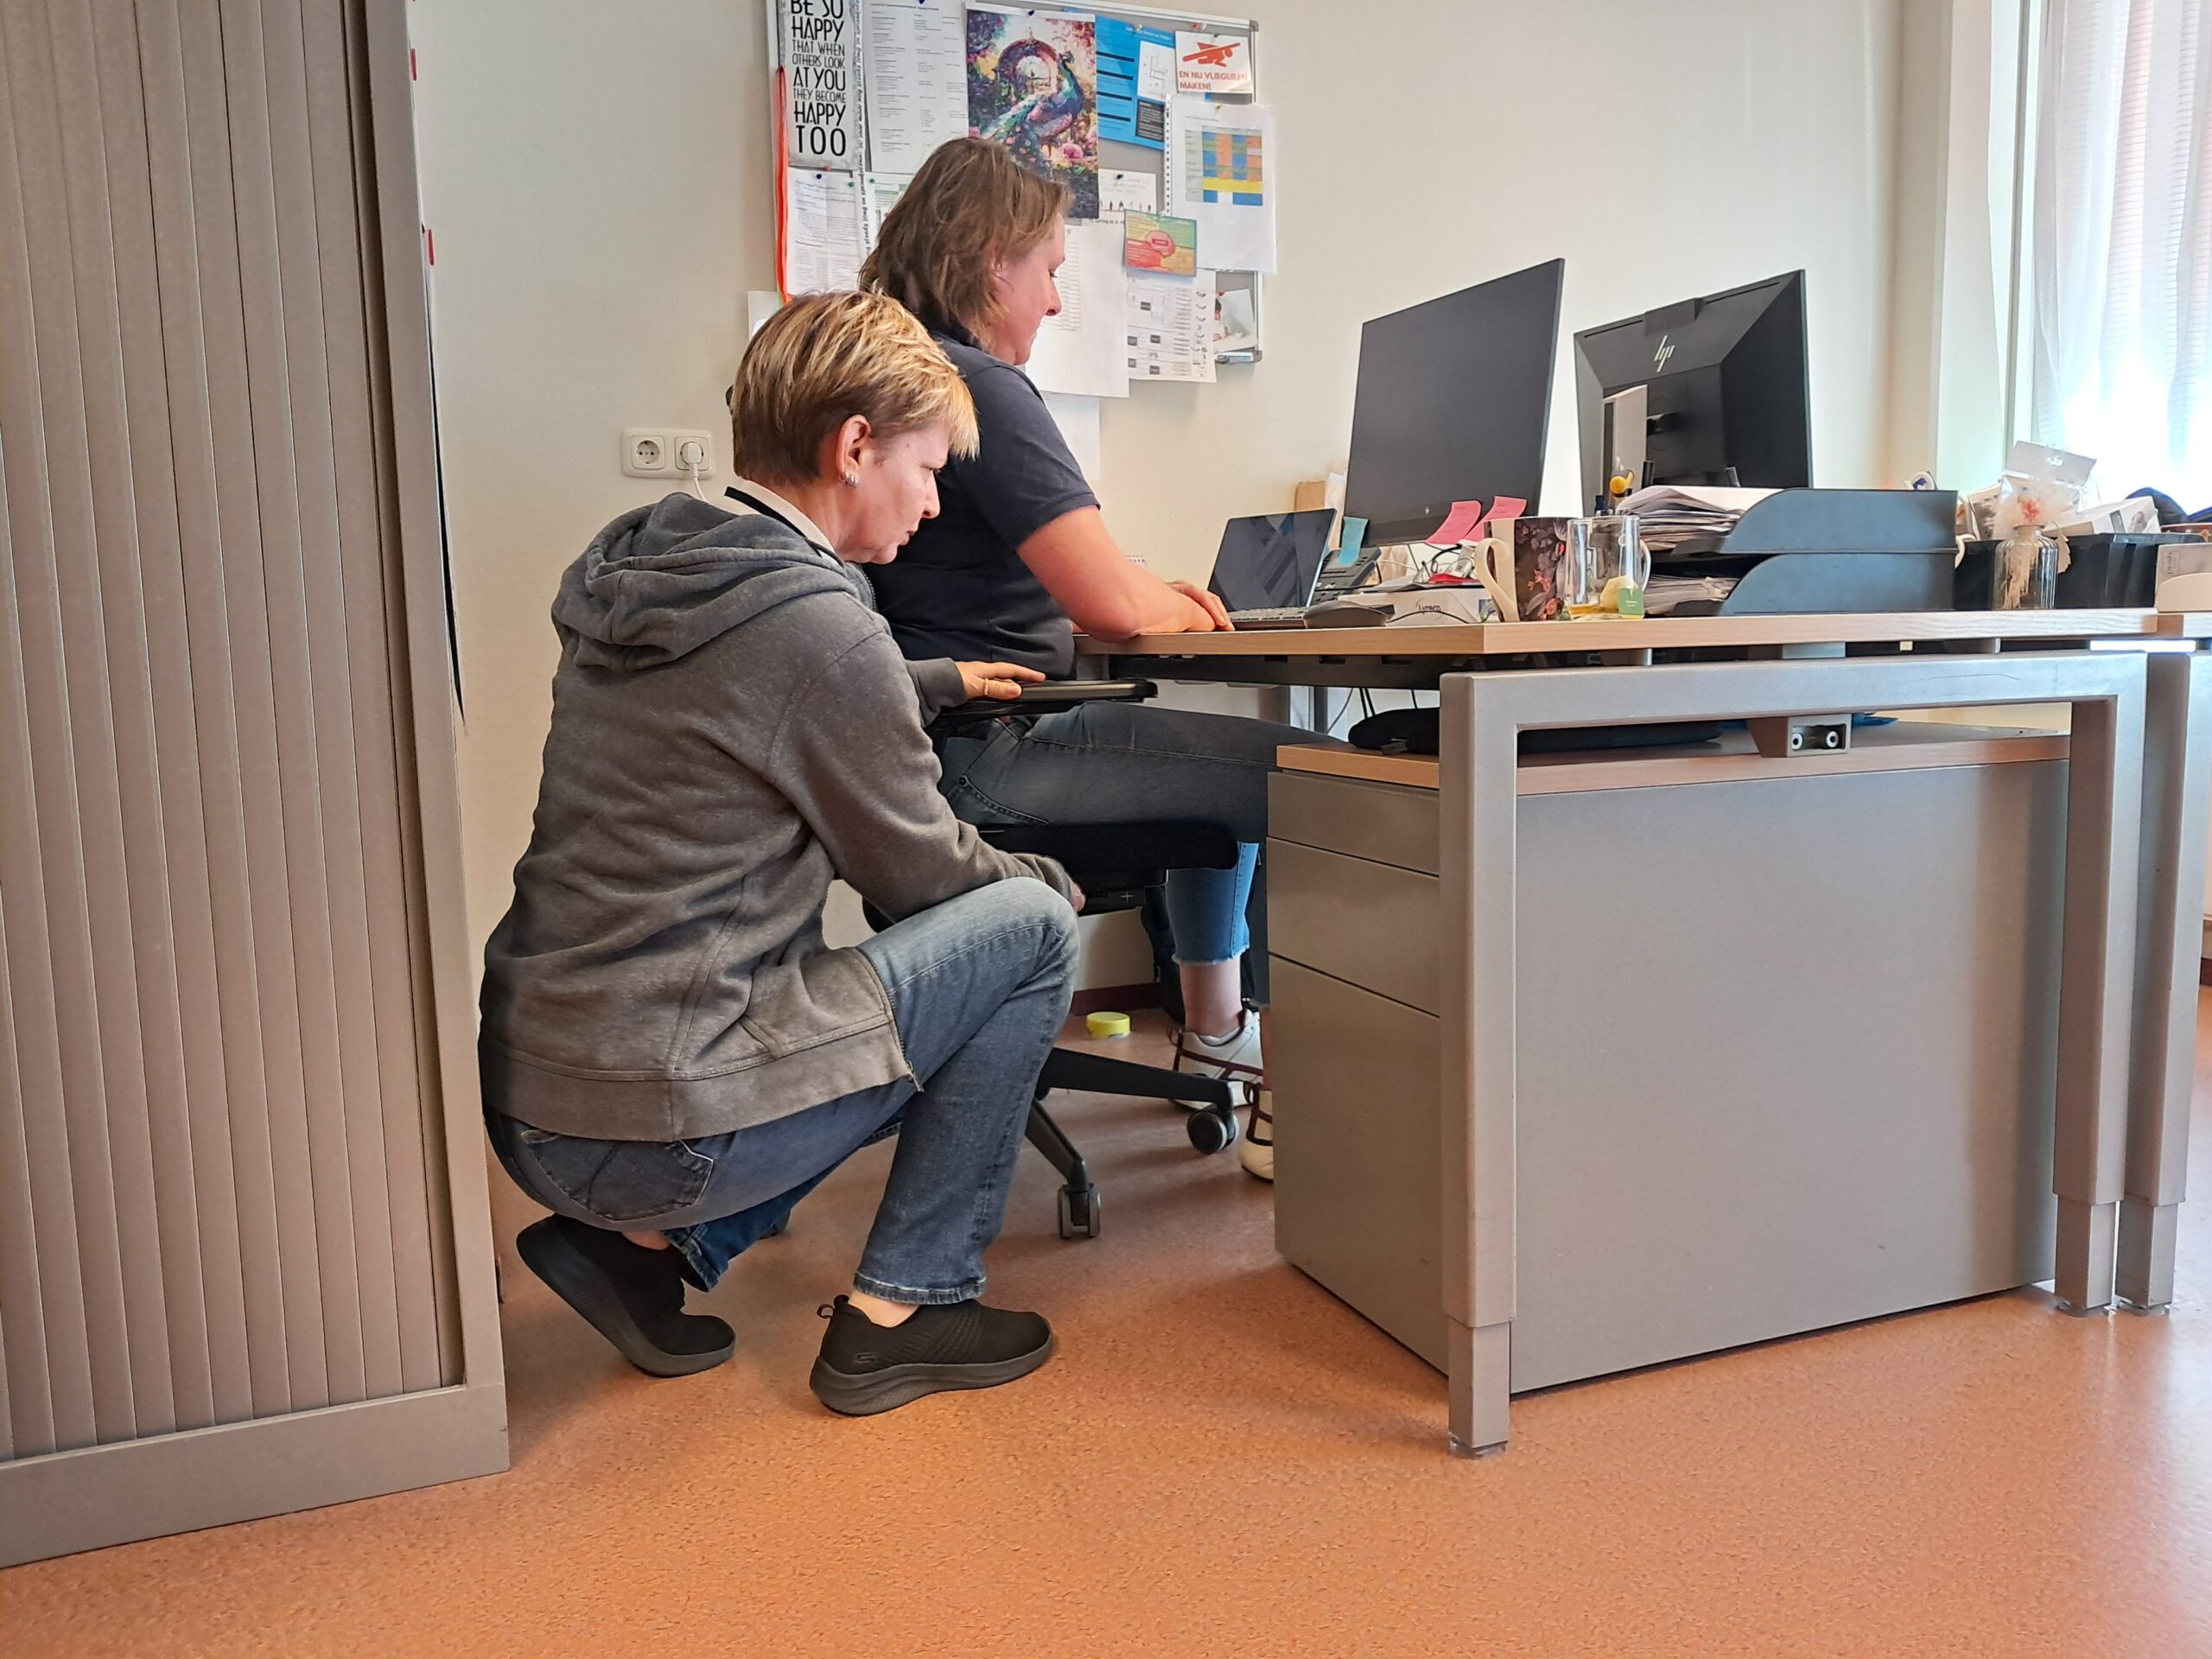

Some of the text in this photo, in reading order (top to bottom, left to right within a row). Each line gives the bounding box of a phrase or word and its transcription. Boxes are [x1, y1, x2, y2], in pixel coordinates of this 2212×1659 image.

[791, 0, 843, 19] BE SO
[791, 16, 844, 42] HAPPY
[792, 39, 845, 57] THAT WHEN
[791, 53, 845, 69] OTHERS LOOK
[793, 67, 846, 91] AT YOU
[1191, 71, 1203, 79] NU
[793, 88, 847, 104] THEY BECOME
[794, 100, 846, 127] HAPPY
[796, 125, 847, 156] TOO
[1653, 334, 1675, 372] hp
